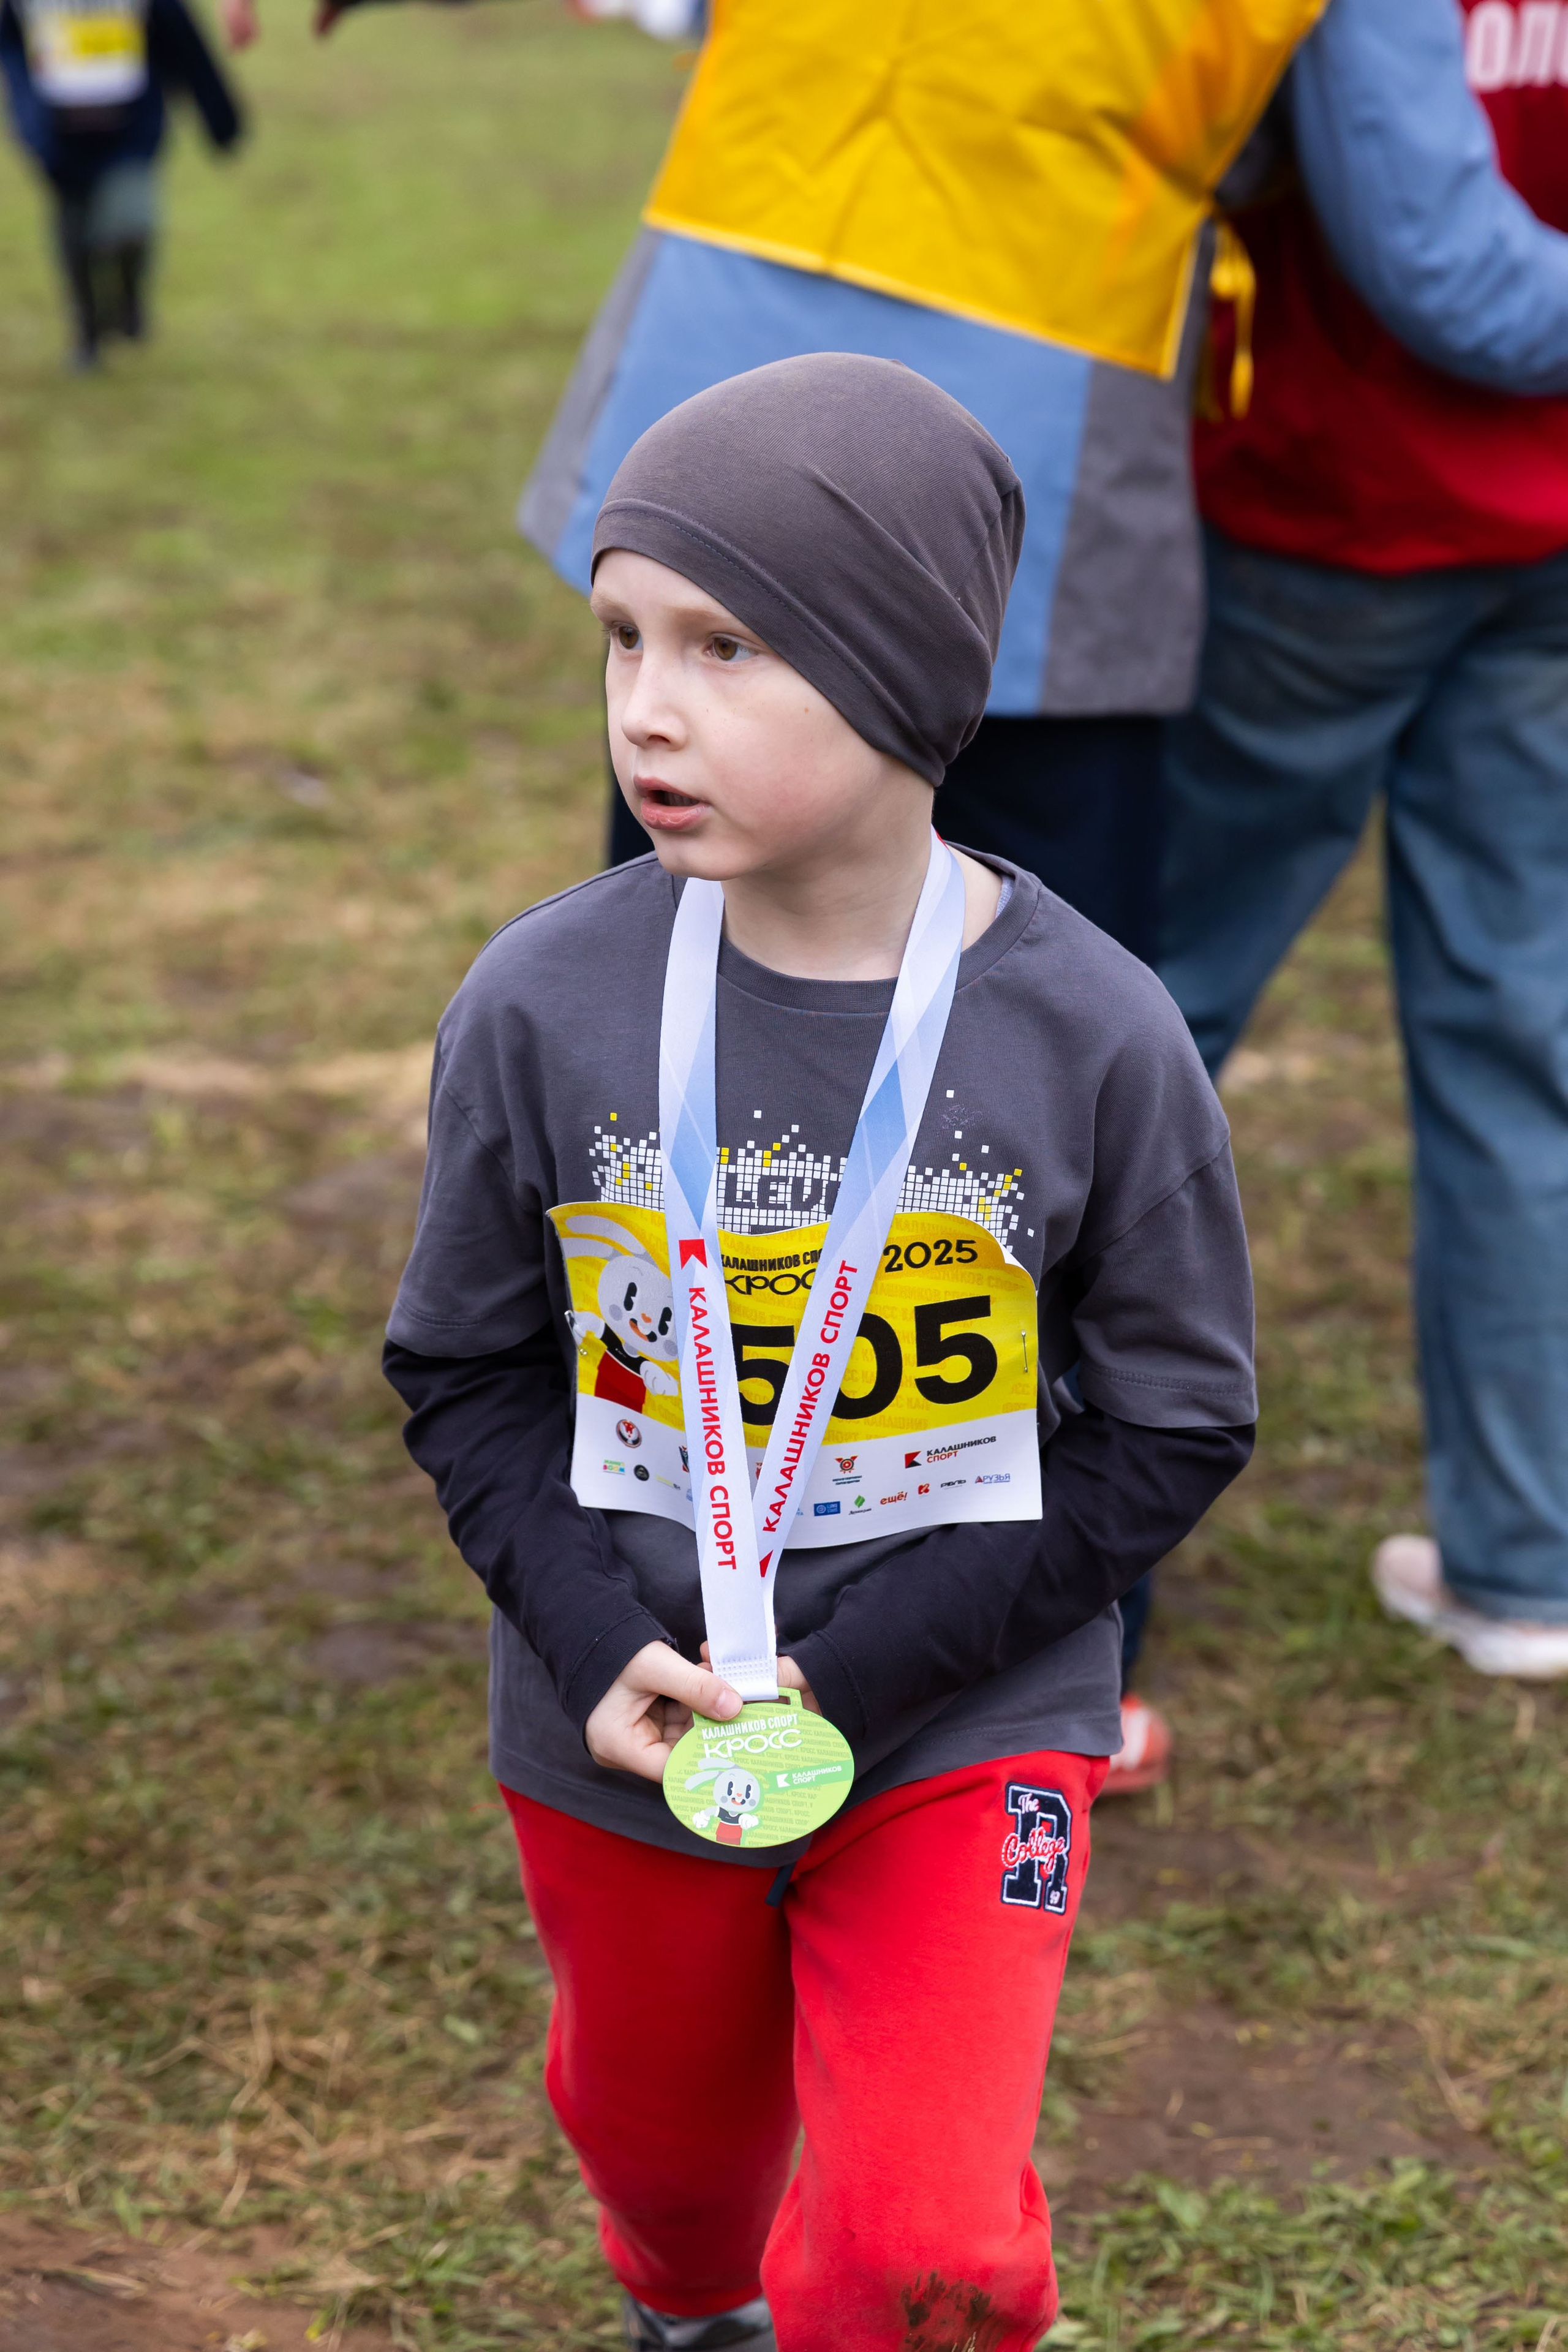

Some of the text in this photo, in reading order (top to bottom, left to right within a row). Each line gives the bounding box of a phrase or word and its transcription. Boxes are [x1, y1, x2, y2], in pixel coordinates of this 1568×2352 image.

[1466, 1, 1568, 91] ОЛ
[883, 1239, 979, 1273] 2025
[730, 1295, 998, 1426] 505
[763, 1352, 831, 1532] КАЛАШНИКОВ
[821, 1260, 858, 1344] СПОРТ
[688, 1287, 736, 1570] КАЛАШНИКОВ СПОРТ
[926, 1436, 997, 1457] КАЛАШНИКОВ
[927, 1450, 959, 1463] СПОРТ
[701, 1714, 798, 1740] КАЛАШНИКОВ СПОРТ
[704, 1728, 803, 1758] КРОСС
[791, 1765, 842, 1779] КАЛАШНИКОВ
[793, 1776, 816, 1785] СПОРТ
[1018, 1792, 1040, 1814] The
[1001, 1826, 1065, 1874] College
